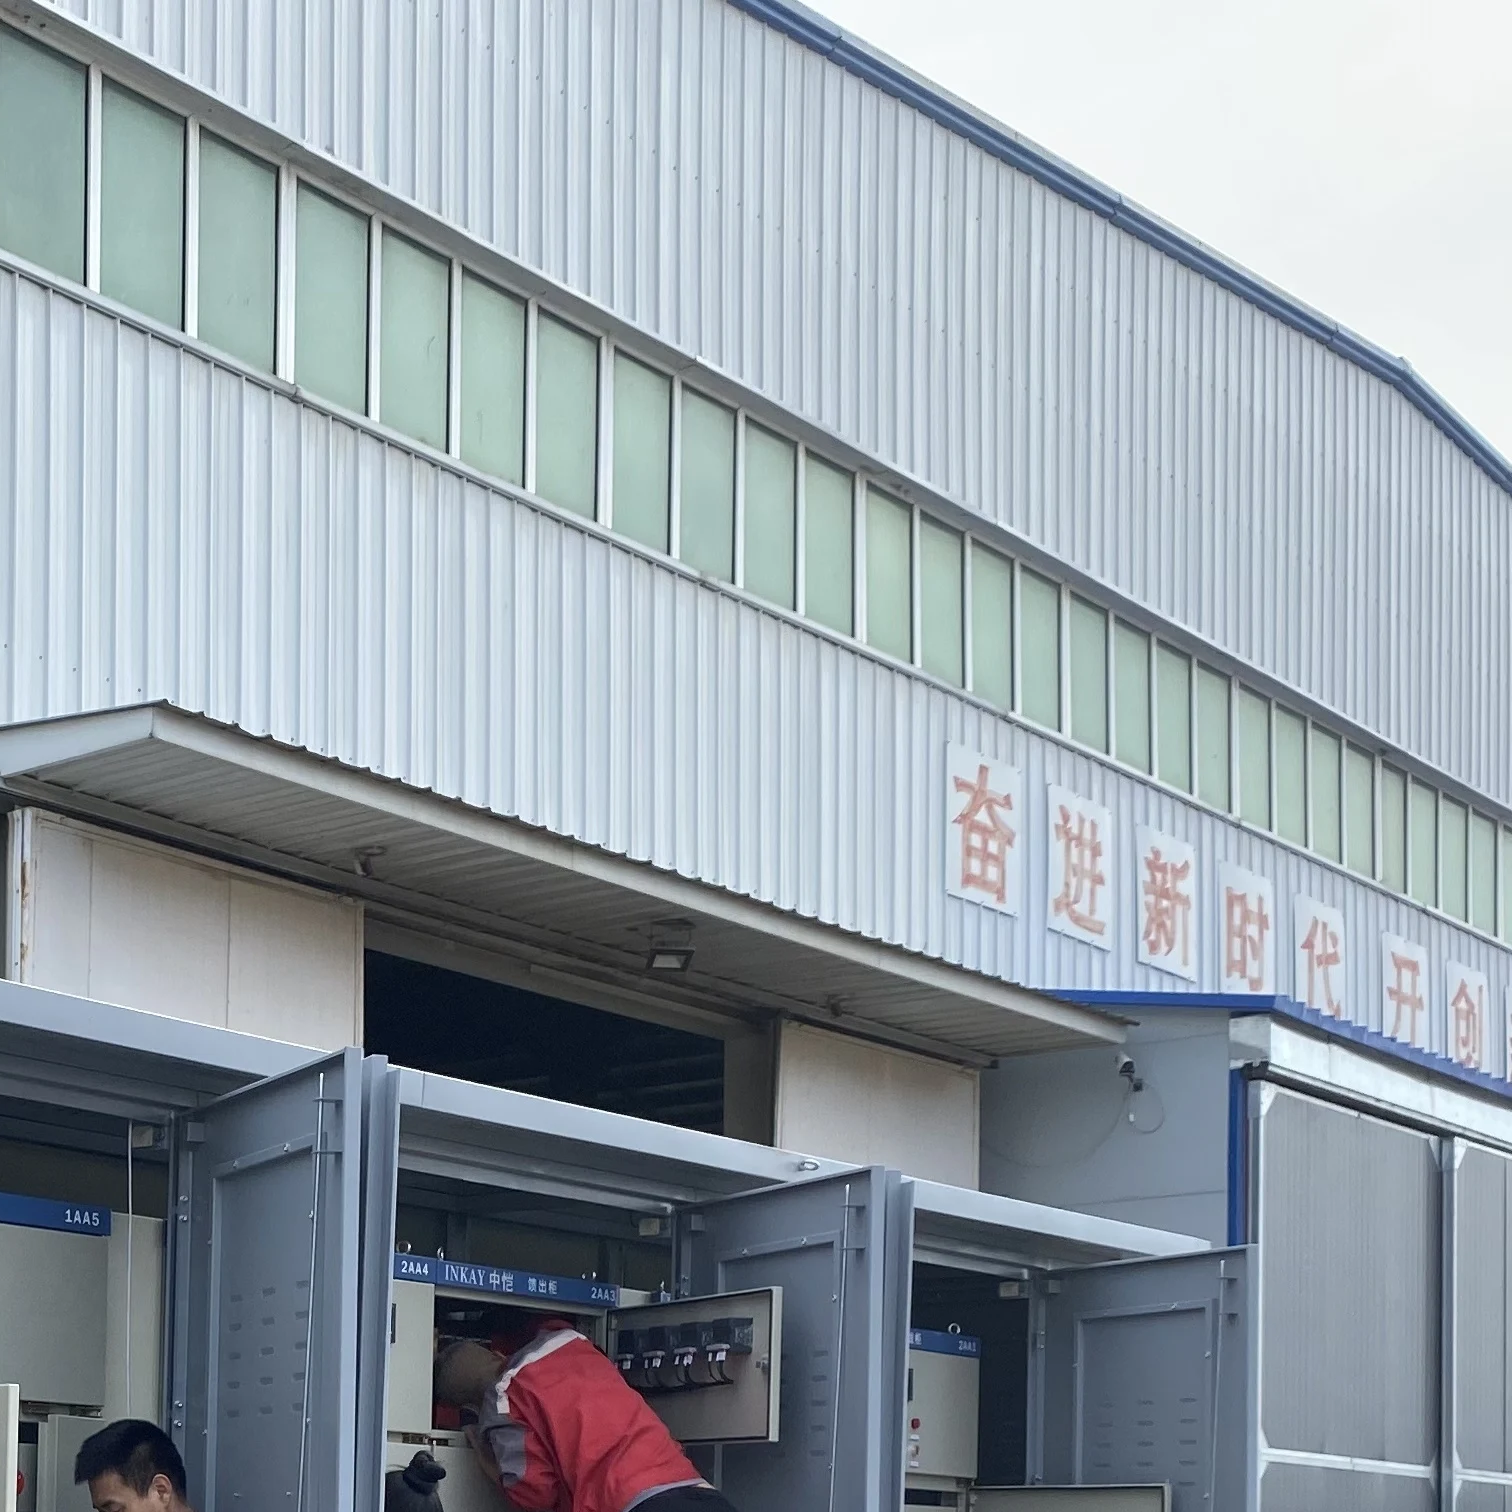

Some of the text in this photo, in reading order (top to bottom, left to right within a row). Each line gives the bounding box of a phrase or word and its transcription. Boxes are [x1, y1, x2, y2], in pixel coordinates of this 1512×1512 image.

[953, 764, 1512, 1084] 奋进新时代开创
[64, 1208, 100, 1227] 1AA5
[401, 1260, 429, 1276] 2AA4
[445, 1264, 616, 1302] INKAY 中恺 馈出柜 2AA3
